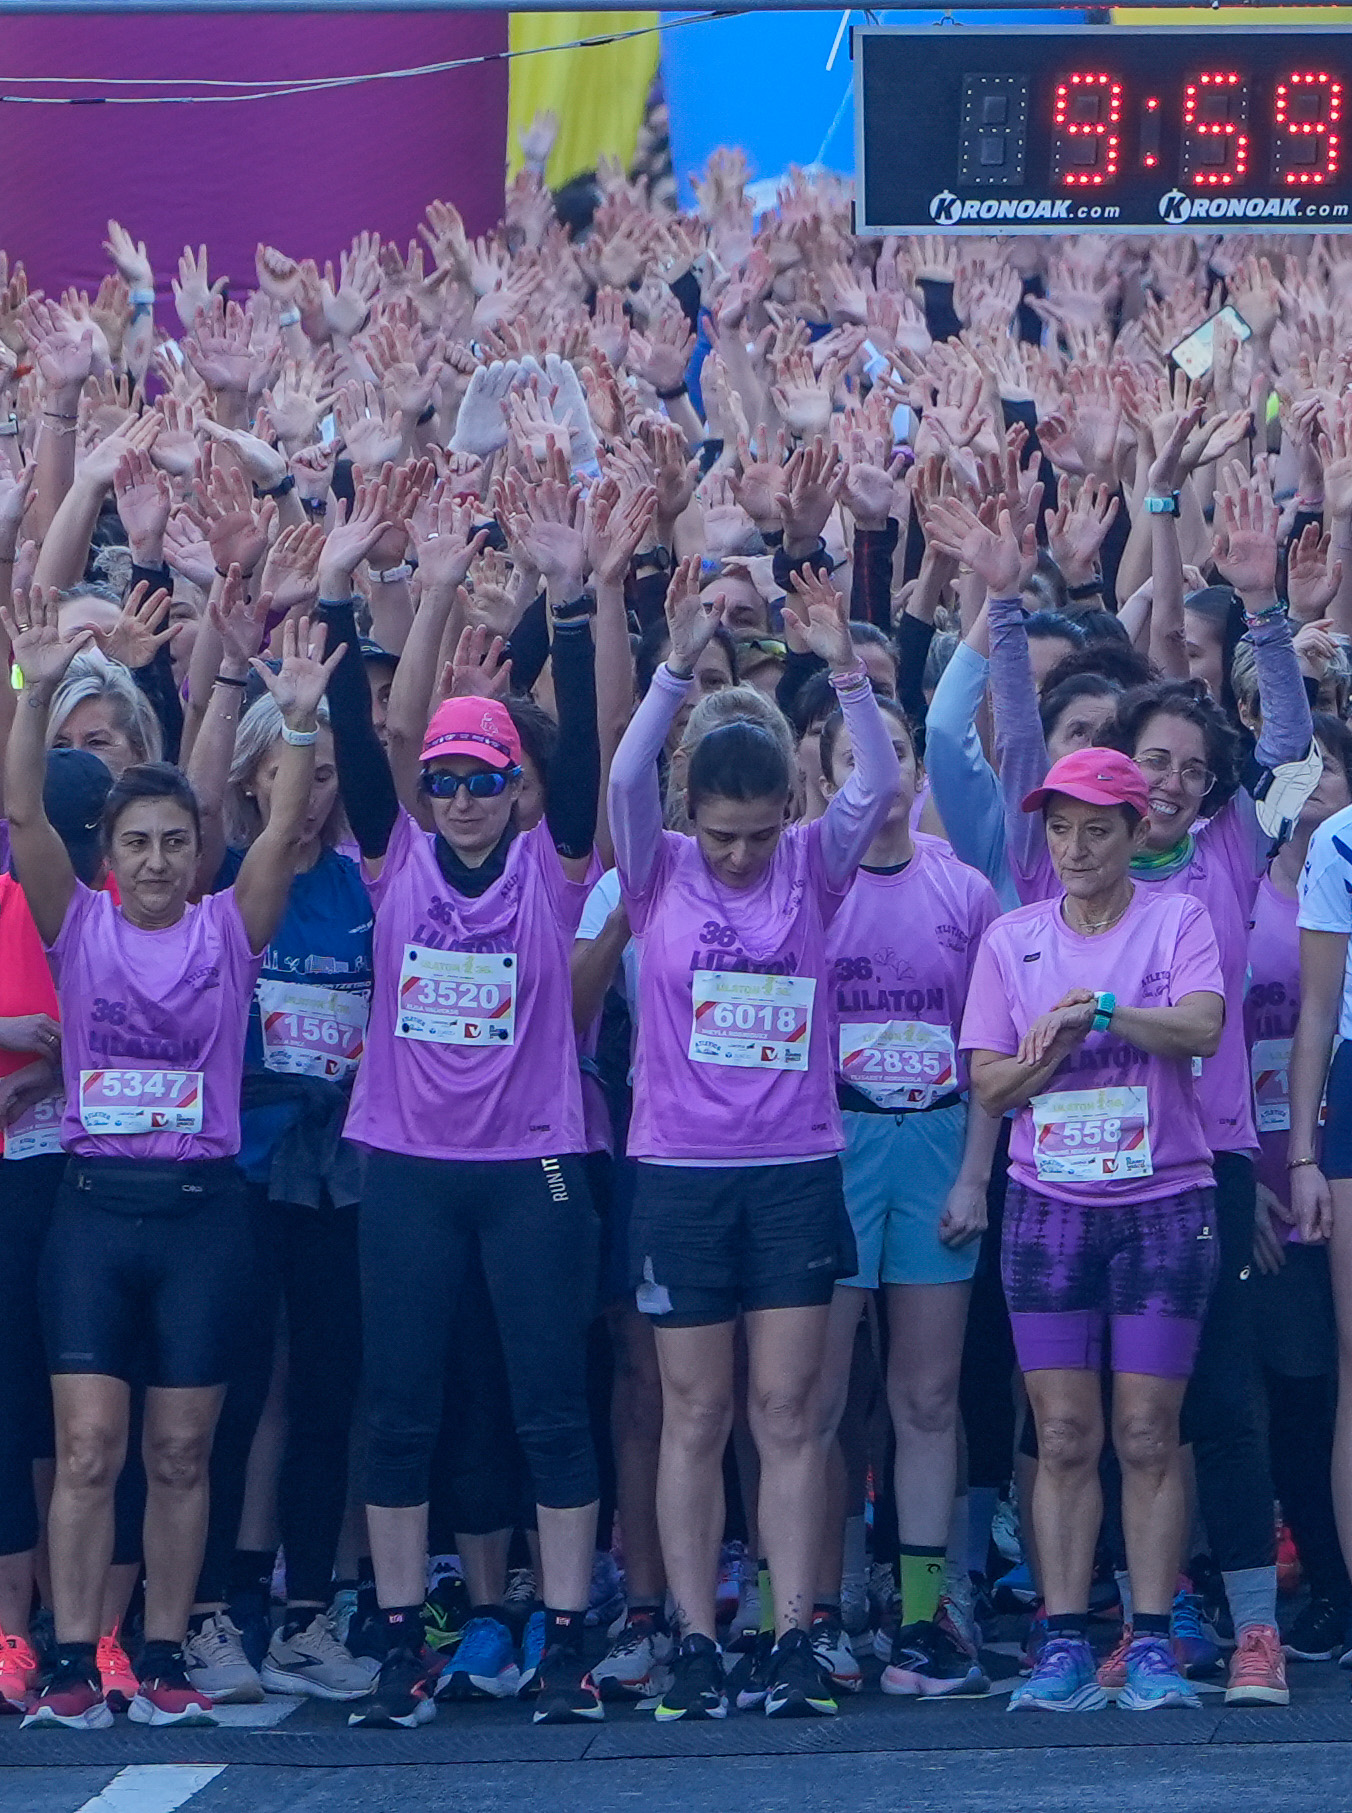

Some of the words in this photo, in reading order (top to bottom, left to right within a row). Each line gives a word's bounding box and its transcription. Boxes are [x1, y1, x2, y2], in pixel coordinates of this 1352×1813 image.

[417, 979, 500, 1010] 3520
[837, 988, 944, 1012] LILATON
[713, 1003, 797, 1032] 6018
[285, 1015, 353, 1048] 1567
[862, 1049, 940, 1075] 2835
[102, 1072, 187, 1098] 5347
[1062, 1119, 1121, 1146] 558
[541, 1158, 560, 1171] IT
[545, 1172, 569, 1202] RUN
